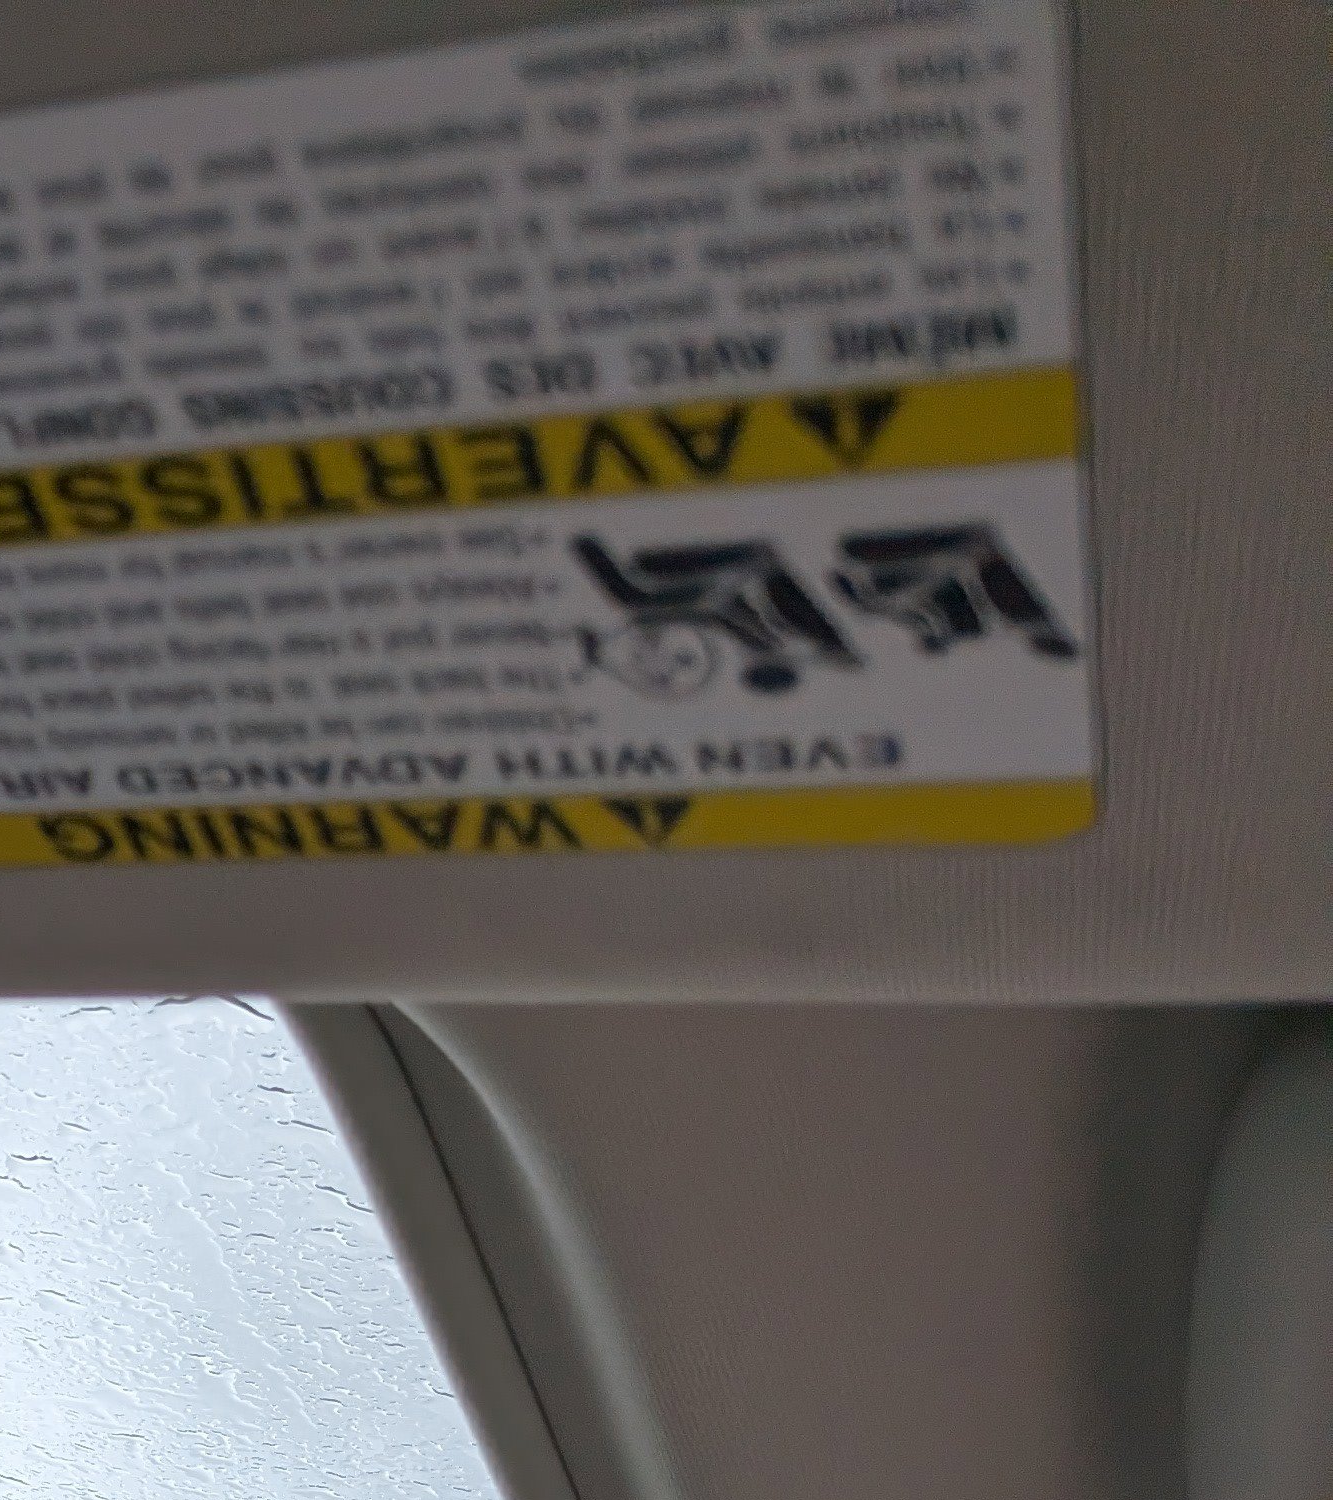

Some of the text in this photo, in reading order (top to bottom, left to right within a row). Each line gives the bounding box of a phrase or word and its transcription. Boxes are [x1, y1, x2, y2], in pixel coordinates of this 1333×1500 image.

[475, 350, 602, 405] DES
[626, 331, 786, 390] AVEC
[176, 366, 461, 434] COUSSINS
[109, 753, 477, 798] ADVANCED
[491, 745, 680, 783] WITH
[691, 734, 905, 774] EVEN
[32, 798, 584, 862] WARNING
